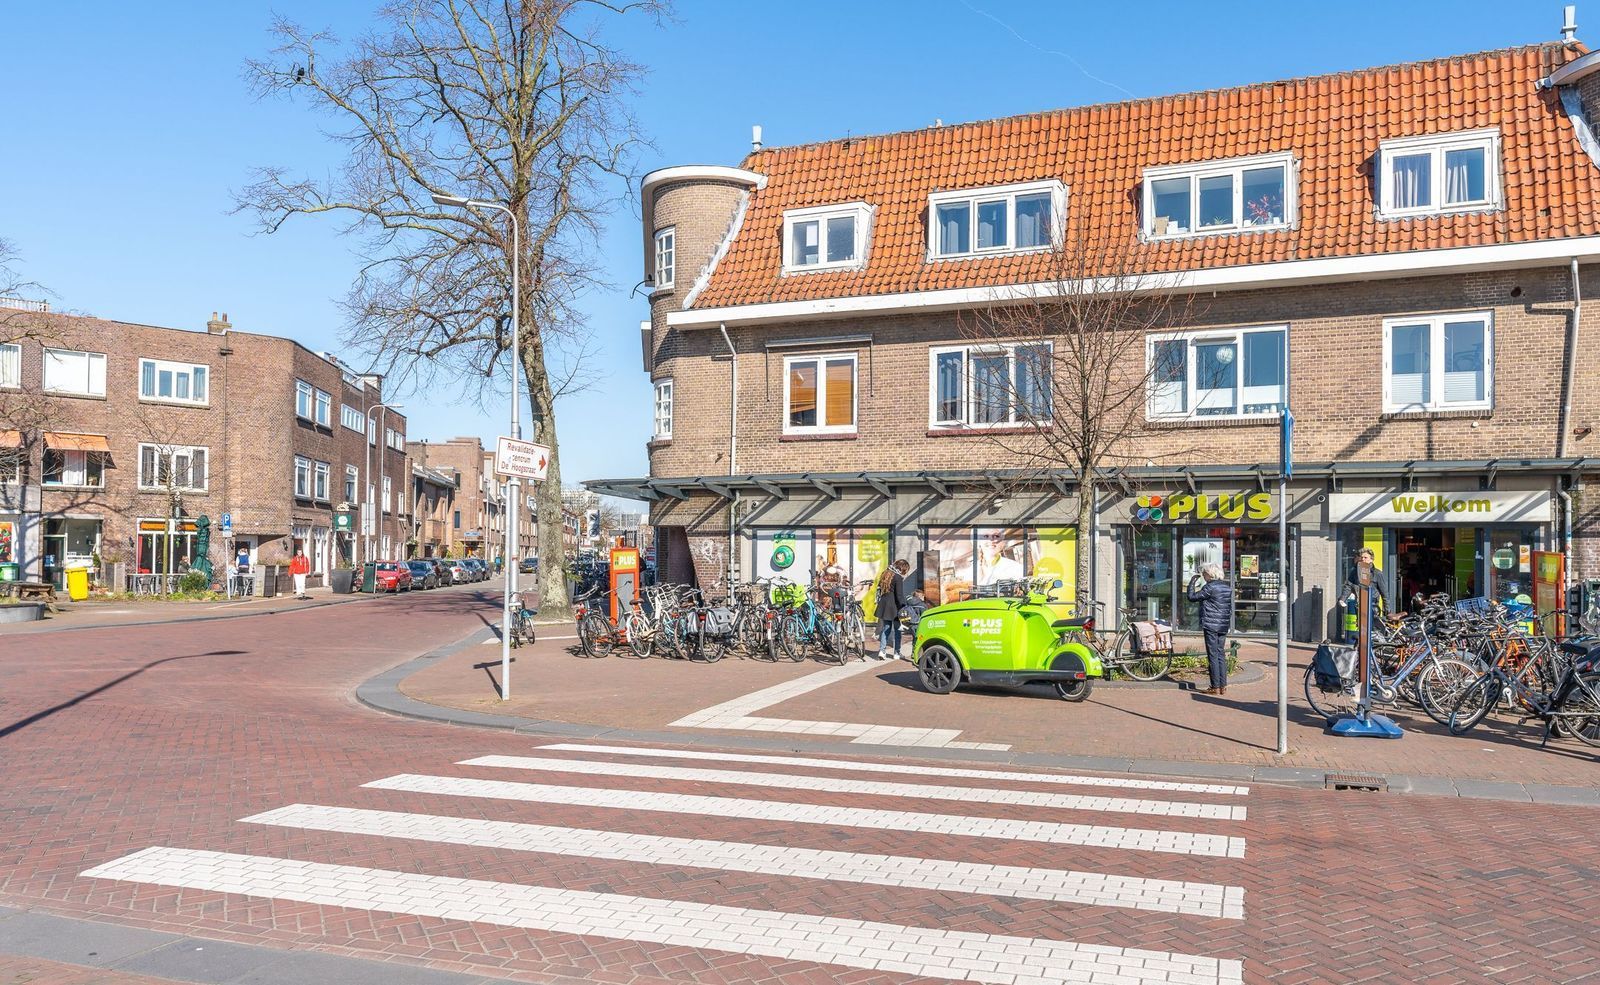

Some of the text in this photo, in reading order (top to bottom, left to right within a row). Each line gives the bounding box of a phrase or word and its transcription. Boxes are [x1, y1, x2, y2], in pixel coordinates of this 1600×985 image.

[501, 461, 509, 470] De
[1168, 493, 1273, 520] PLUS
[1391, 495, 1491, 513] Welkom
[224, 514, 230, 525] P
[618, 555, 636, 566] PLUS
[971, 618, 1003, 627] PLUS
[971, 627, 1002, 636] express
